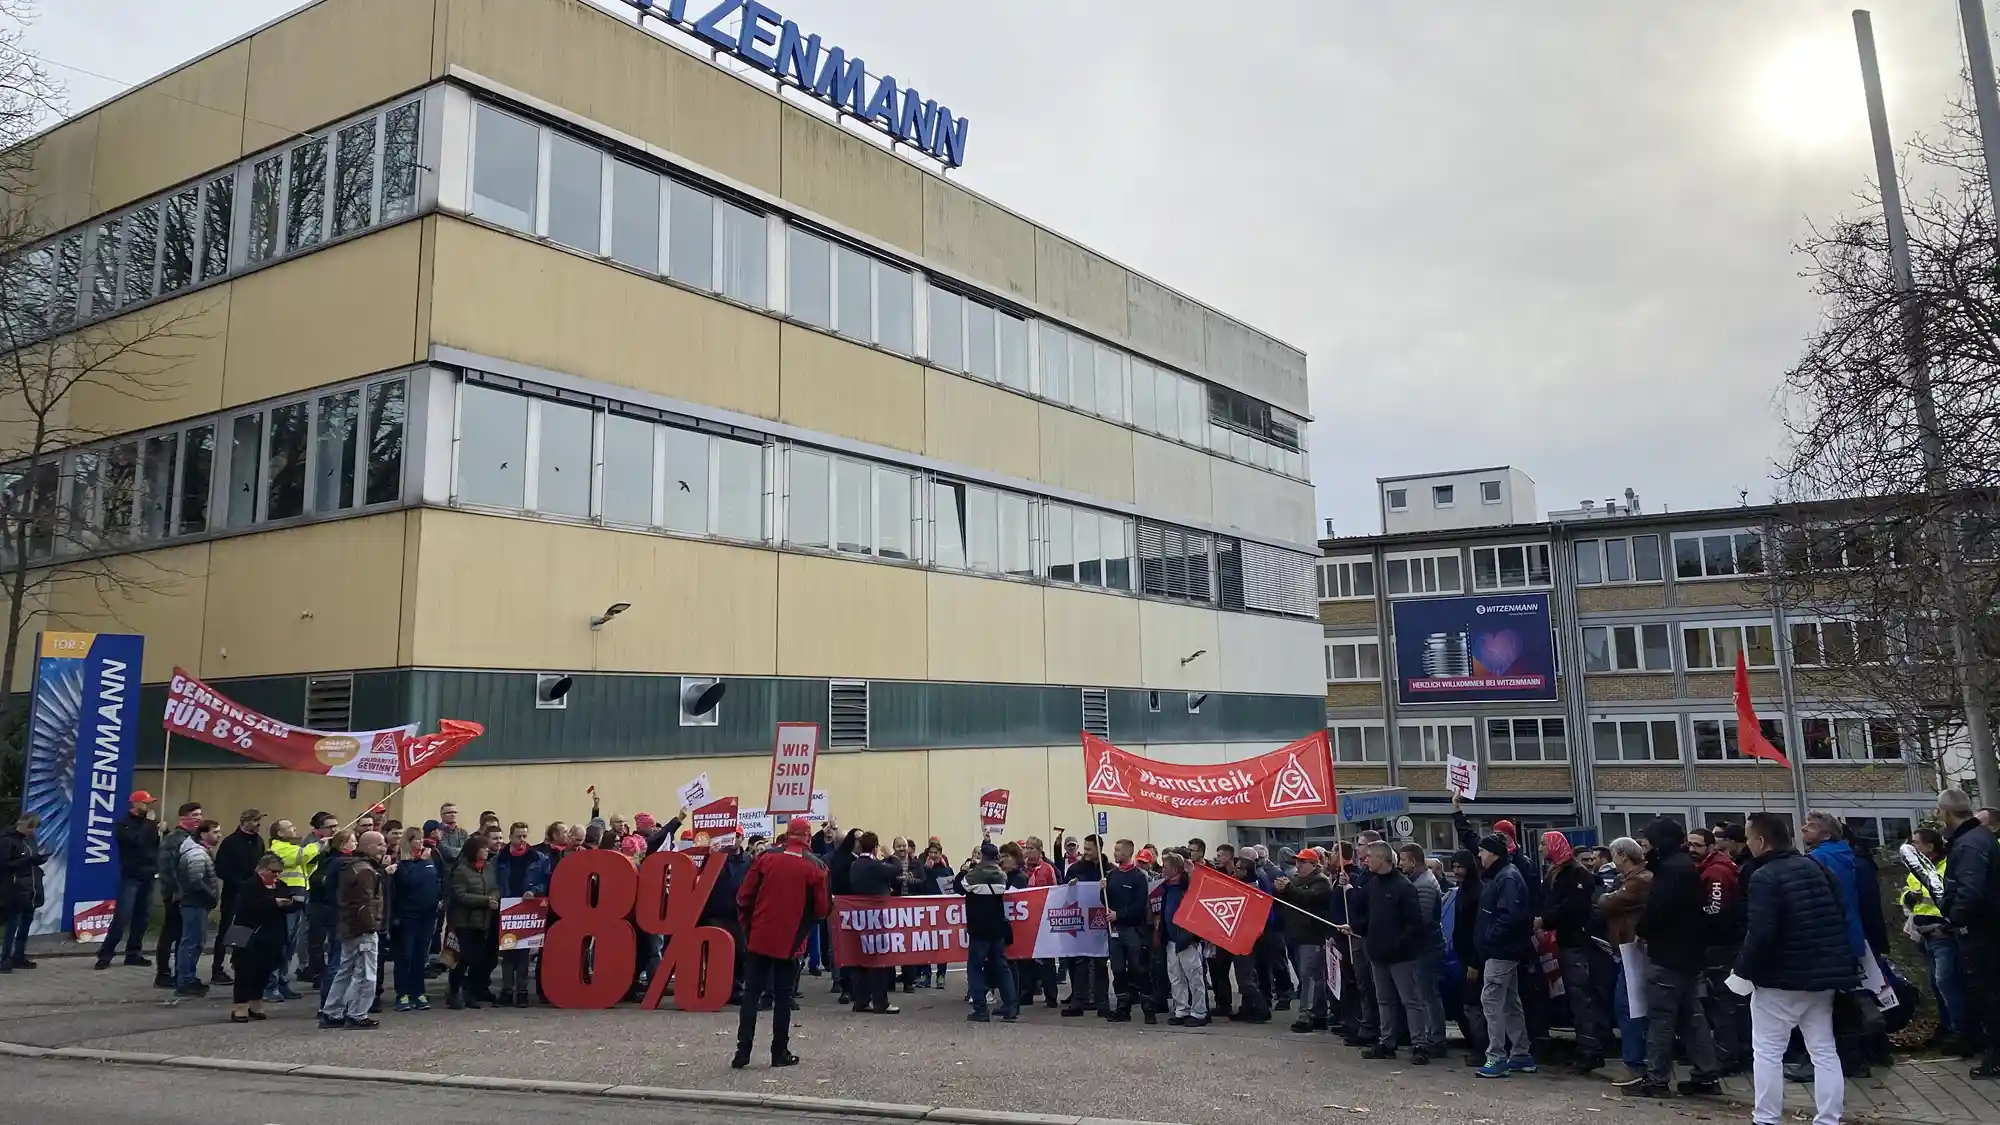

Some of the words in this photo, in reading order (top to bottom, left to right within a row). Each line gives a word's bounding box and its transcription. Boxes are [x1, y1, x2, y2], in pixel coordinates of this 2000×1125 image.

[1486, 603, 1538, 613] WITZENMANN
[52, 639, 76, 650] TOR
[79, 641, 86, 650] 2
[1412, 681, 1441, 689] HERZLICH
[1442, 680, 1485, 688] WILLKOMMEN
[1486, 679, 1496, 687] BEI
[1497, 678, 1541, 687] WITZENMANN
[170, 675, 290, 739] GEMEINSAM
[163, 697, 210, 733] FÜR
[212, 718, 253, 749] 8%
[782, 743, 809, 757] WIR
[84, 658, 127, 865] WITZENMANN
[775, 763, 810, 777] SIND
[776, 782, 805, 796] VIEL
[1171, 796, 1208, 808] gutes
[1211, 790, 1251, 806] Recht
[1353, 795, 1404, 816] WITZENMANN
[694, 818, 737, 829] VERDIENT!
[1400, 820, 1409, 832] 10
[839, 904, 940, 931] ZUKUNFT
[1048, 908, 1081, 918] ZUKUNFT
[501, 919, 546, 930] VERDIENT!
[540, 850, 736, 1012] 8%
[860, 932, 907, 955] NUR
[911, 929, 952, 951] MIT
